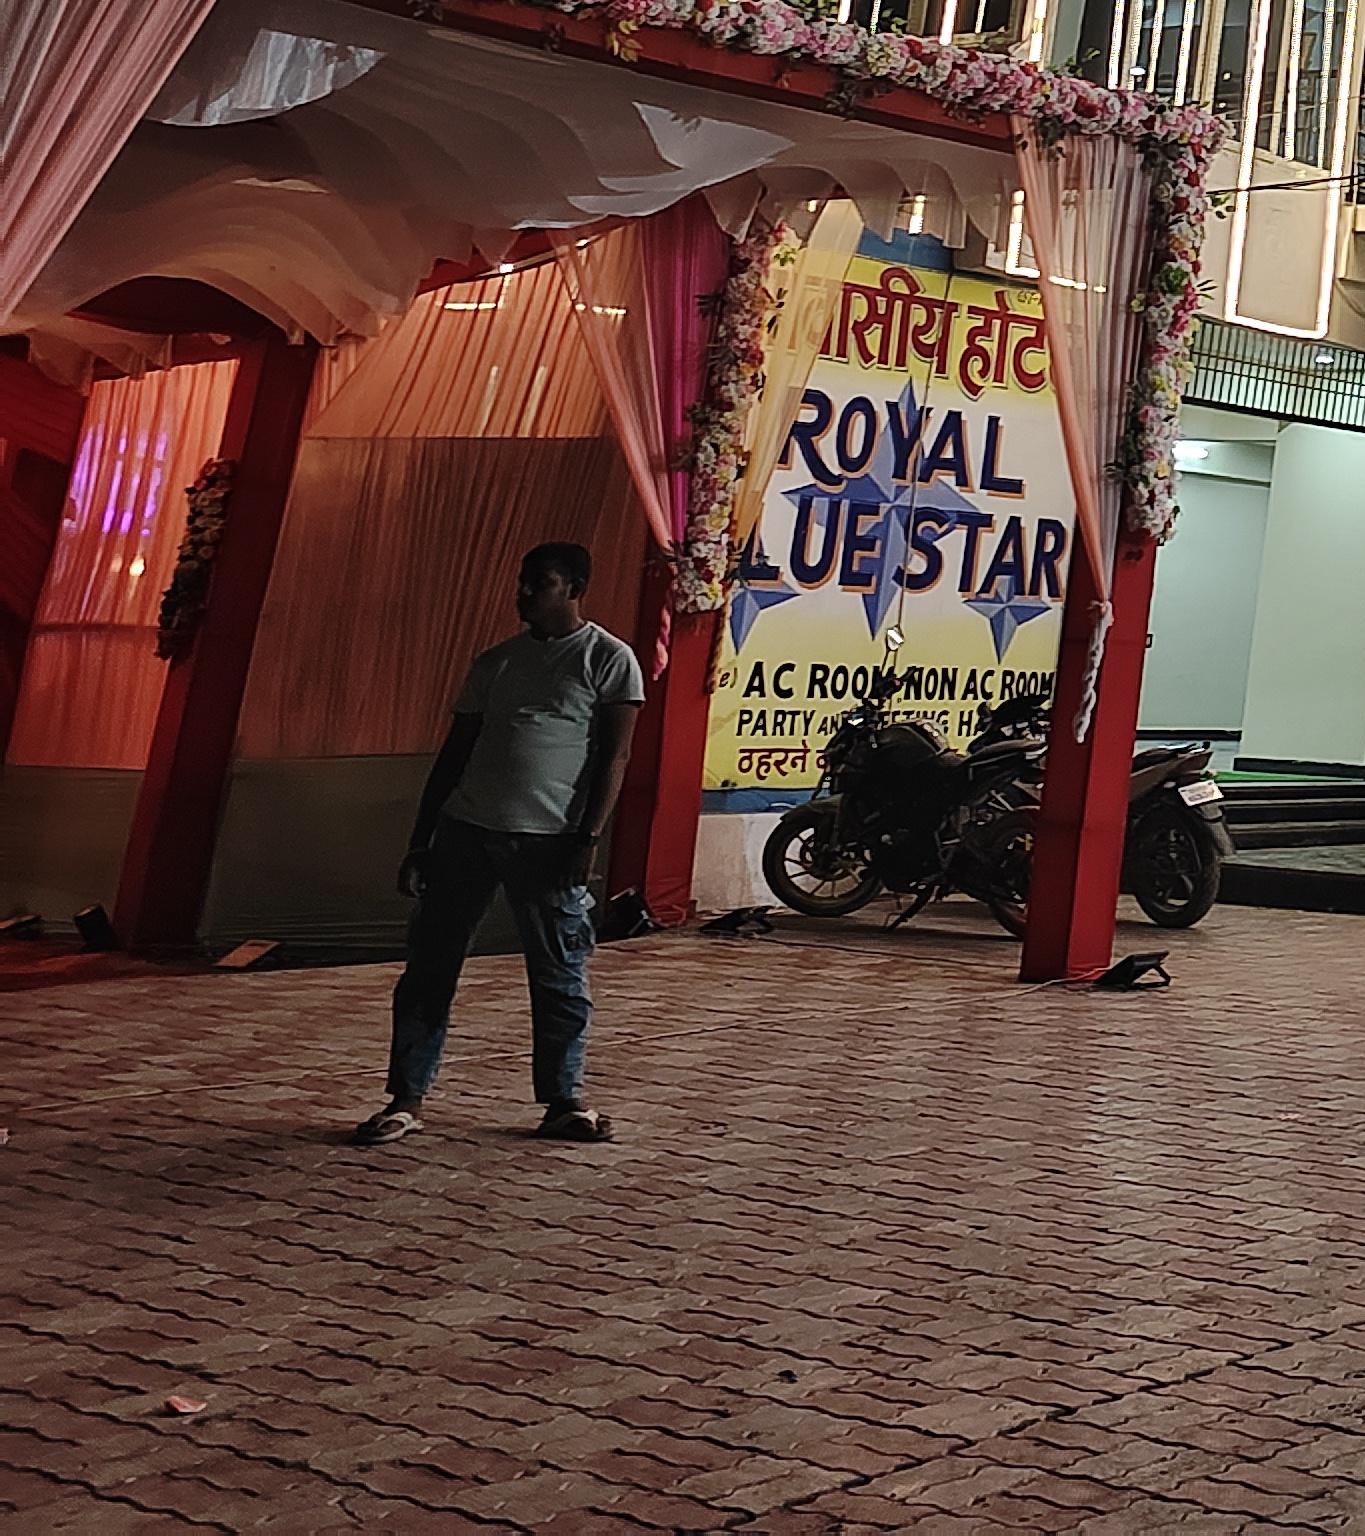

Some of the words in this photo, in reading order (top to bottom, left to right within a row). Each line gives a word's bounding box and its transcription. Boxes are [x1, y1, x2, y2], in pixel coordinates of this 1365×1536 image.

[958, 290, 1047, 399] होट
[776, 388, 1026, 498] ROYAL
[734, 496, 883, 595] LUE
[897, 509, 1068, 603] STAR
[742, 661, 797, 700] AC
[902, 666, 958, 701] NON
[961, 668, 995, 700] AC
[735, 709, 816, 737] PARTY
[737, 739, 812, 781] ठहरने
